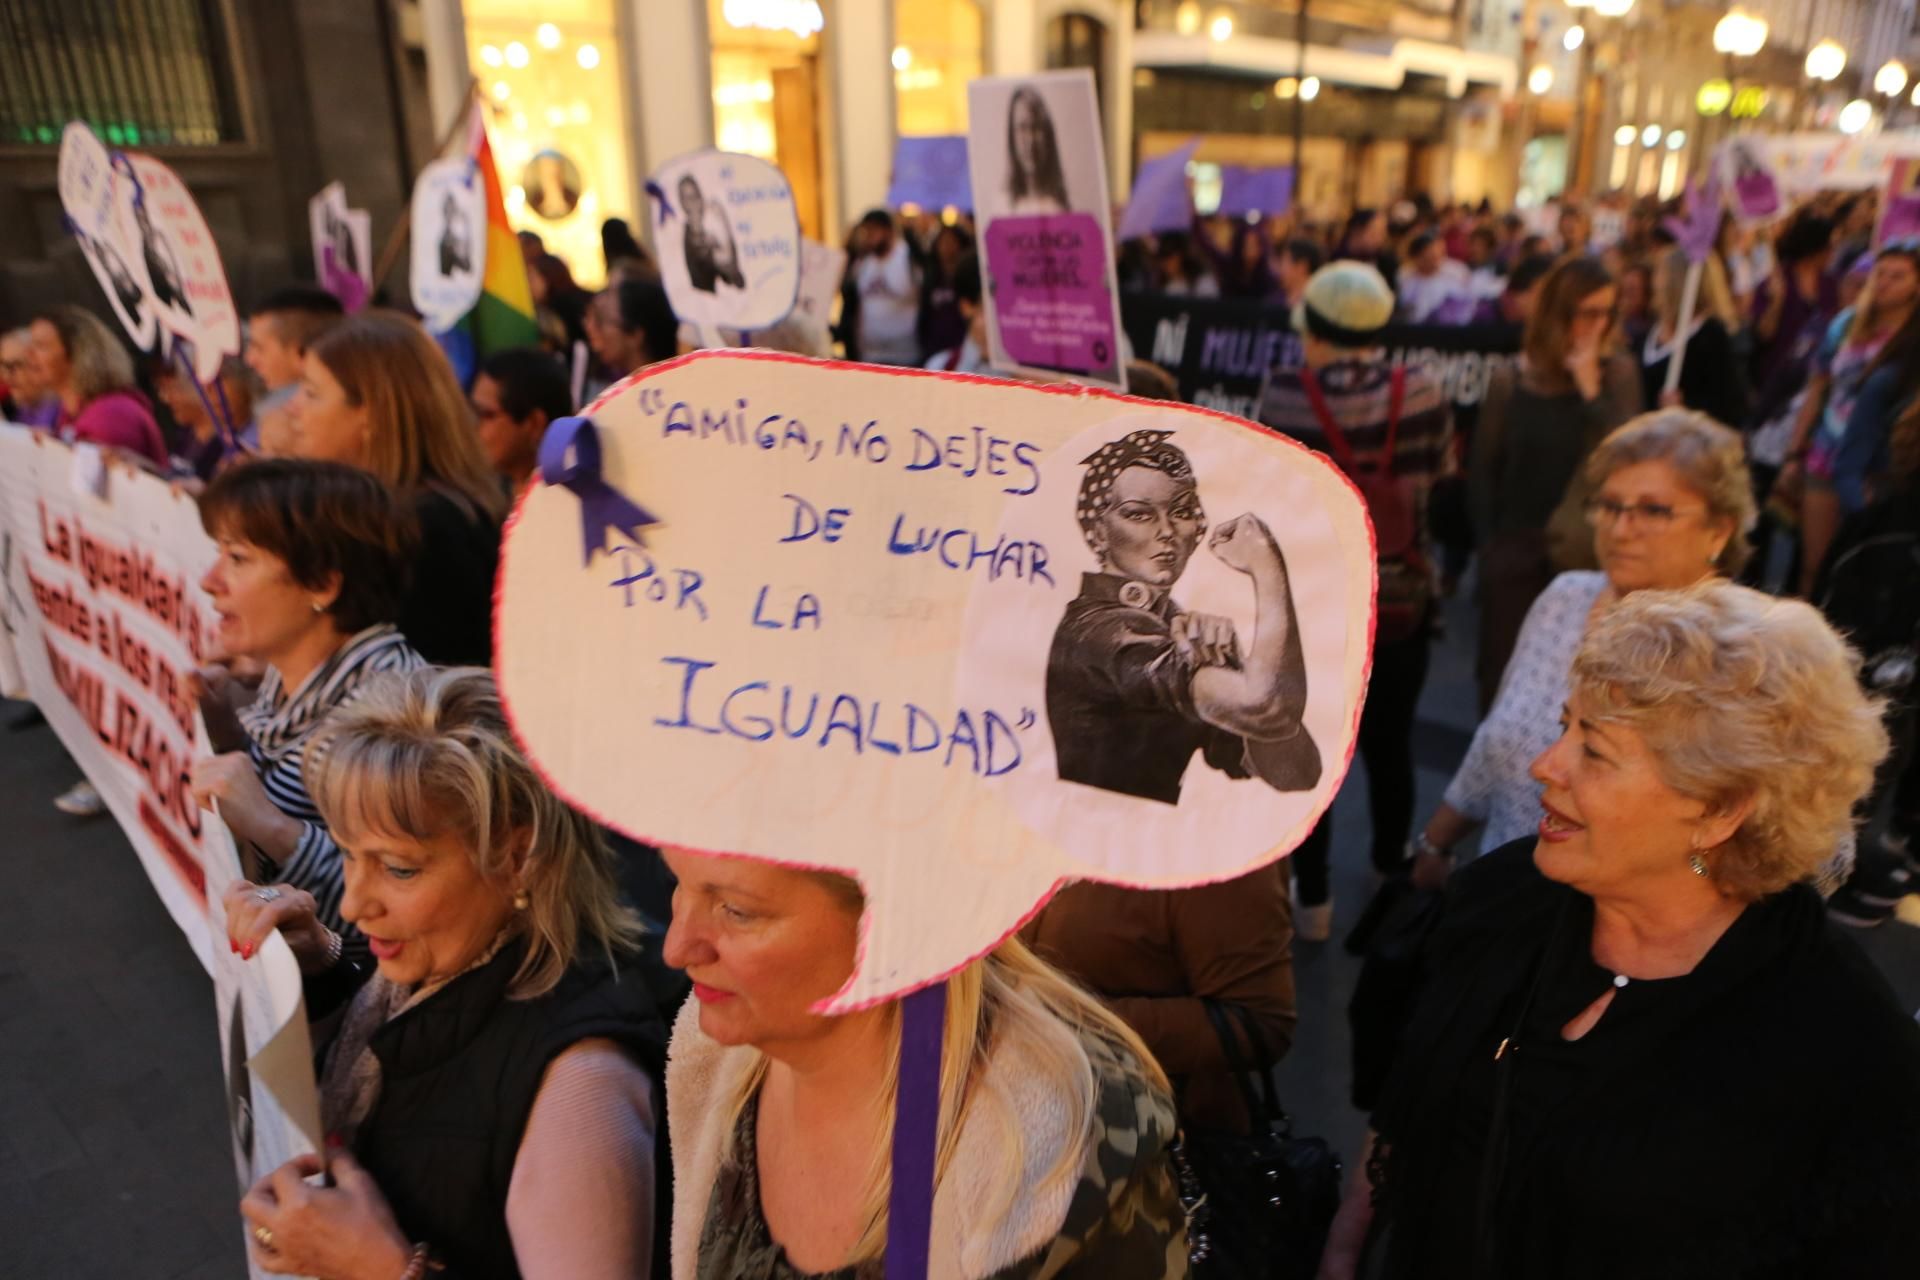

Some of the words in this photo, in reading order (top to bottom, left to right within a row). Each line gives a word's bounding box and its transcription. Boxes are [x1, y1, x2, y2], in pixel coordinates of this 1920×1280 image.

[836, 420, 891, 464] NO
[904, 427, 1042, 496] DEJES
[37, 497, 73, 566] La
[74, 513, 187, 636] igualdad
[778, 493, 851, 544] DE
[887, 512, 1056, 588] LUCHAR
[608, 545, 708, 622] POR
[751, 584, 822, 631] LA
